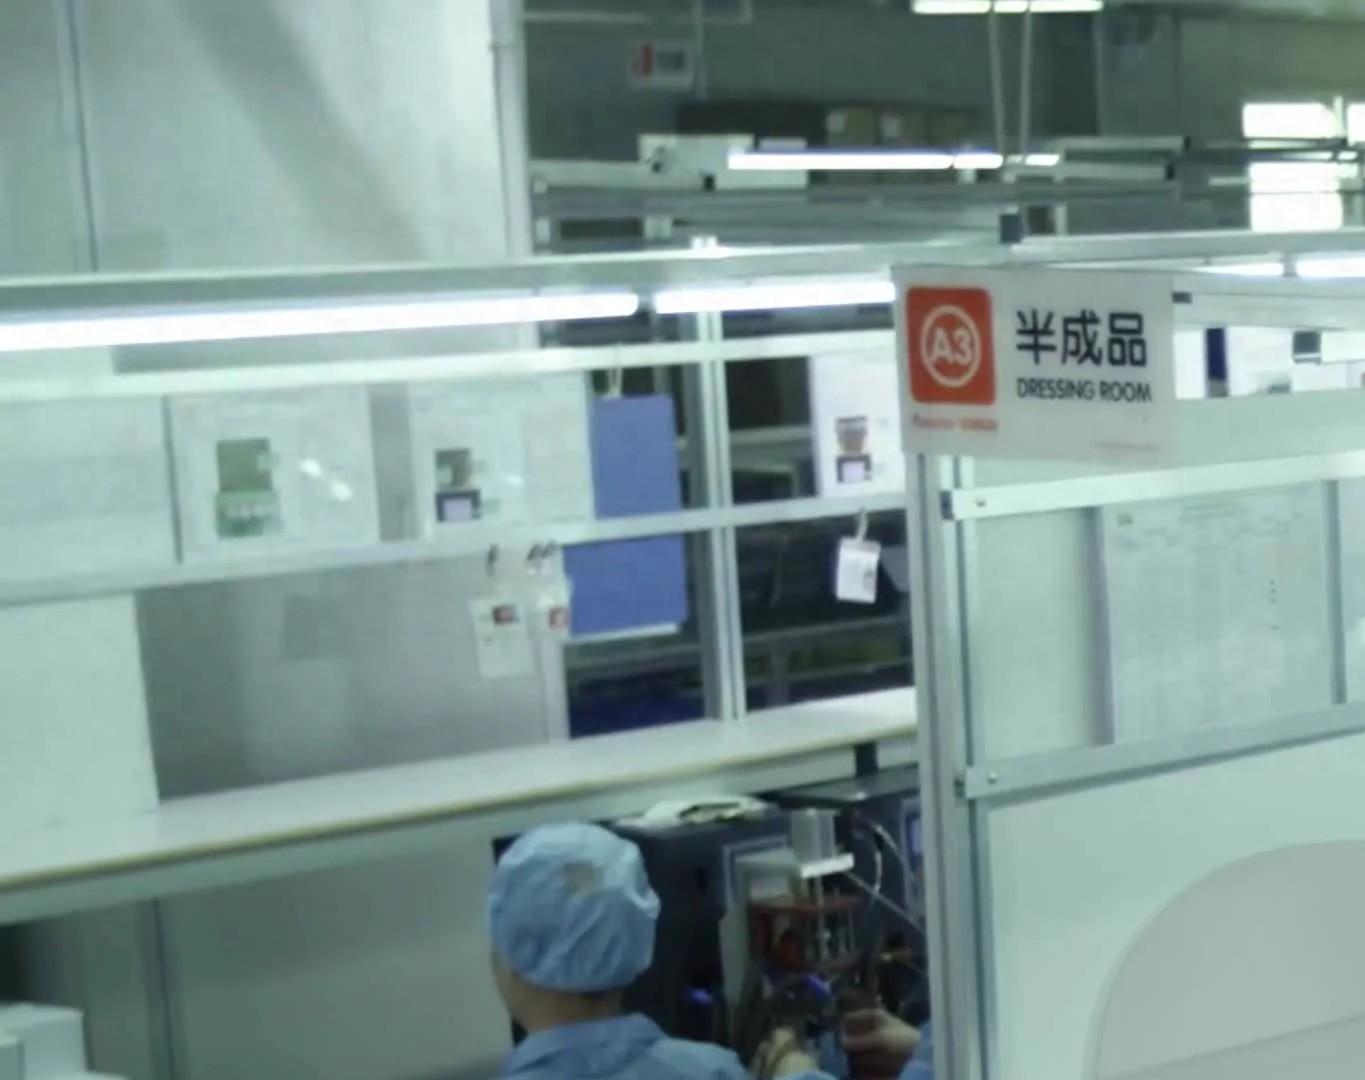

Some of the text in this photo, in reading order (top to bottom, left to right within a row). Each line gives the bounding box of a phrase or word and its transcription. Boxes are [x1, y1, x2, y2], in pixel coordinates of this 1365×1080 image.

[929, 327, 975, 366] A3
[1015, 308, 1148, 368] 半成品
[1016, 377, 1153, 403] DRESSING ROOM
